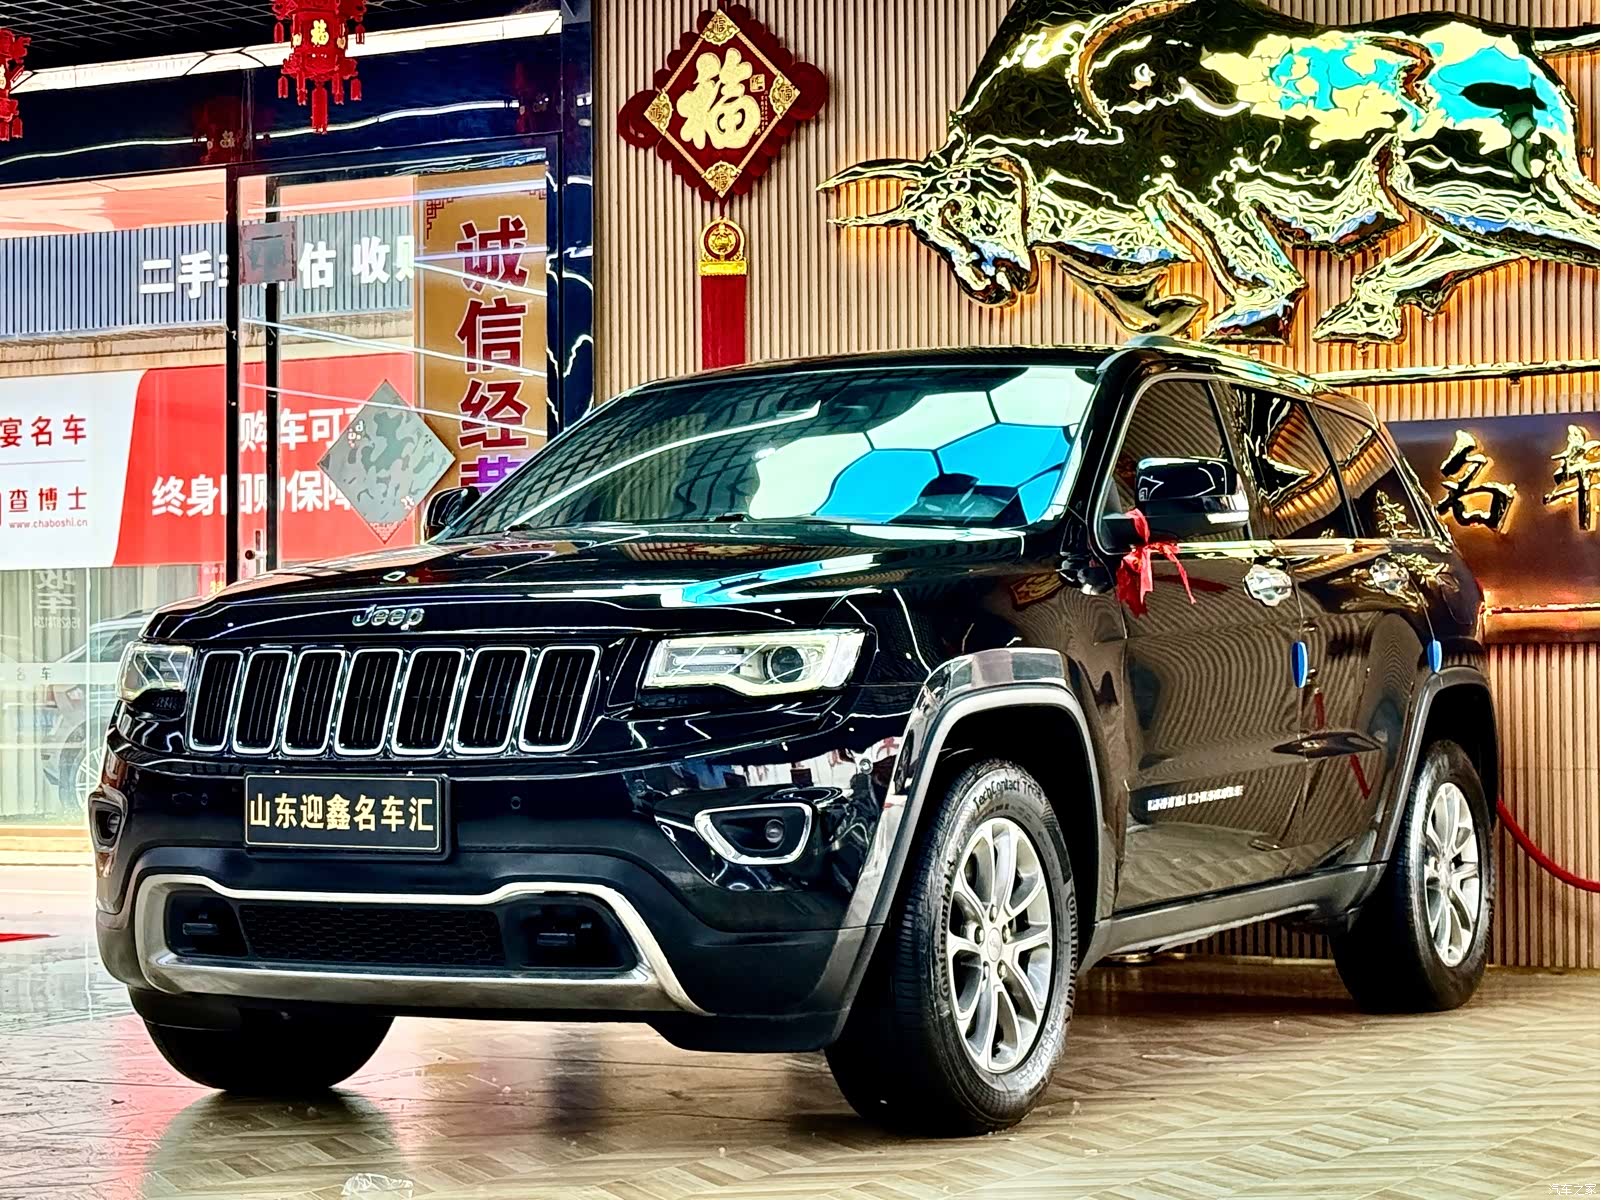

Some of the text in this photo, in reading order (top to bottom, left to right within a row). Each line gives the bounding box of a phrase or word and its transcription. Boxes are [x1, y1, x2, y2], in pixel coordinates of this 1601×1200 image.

[676, 47, 762, 150] 福
[139, 240, 337, 300] 二手估
[0, 414, 87, 448] 宴名车
[239, 407, 358, 452] 购车可
[8, 486, 87, 513] 查博士
[8, 517, 88, 529] www.chaboshi.cn
[352, 604, 425, 630] Jeep
[249, 793, 434, 832] 山东迎鑫名车汇
